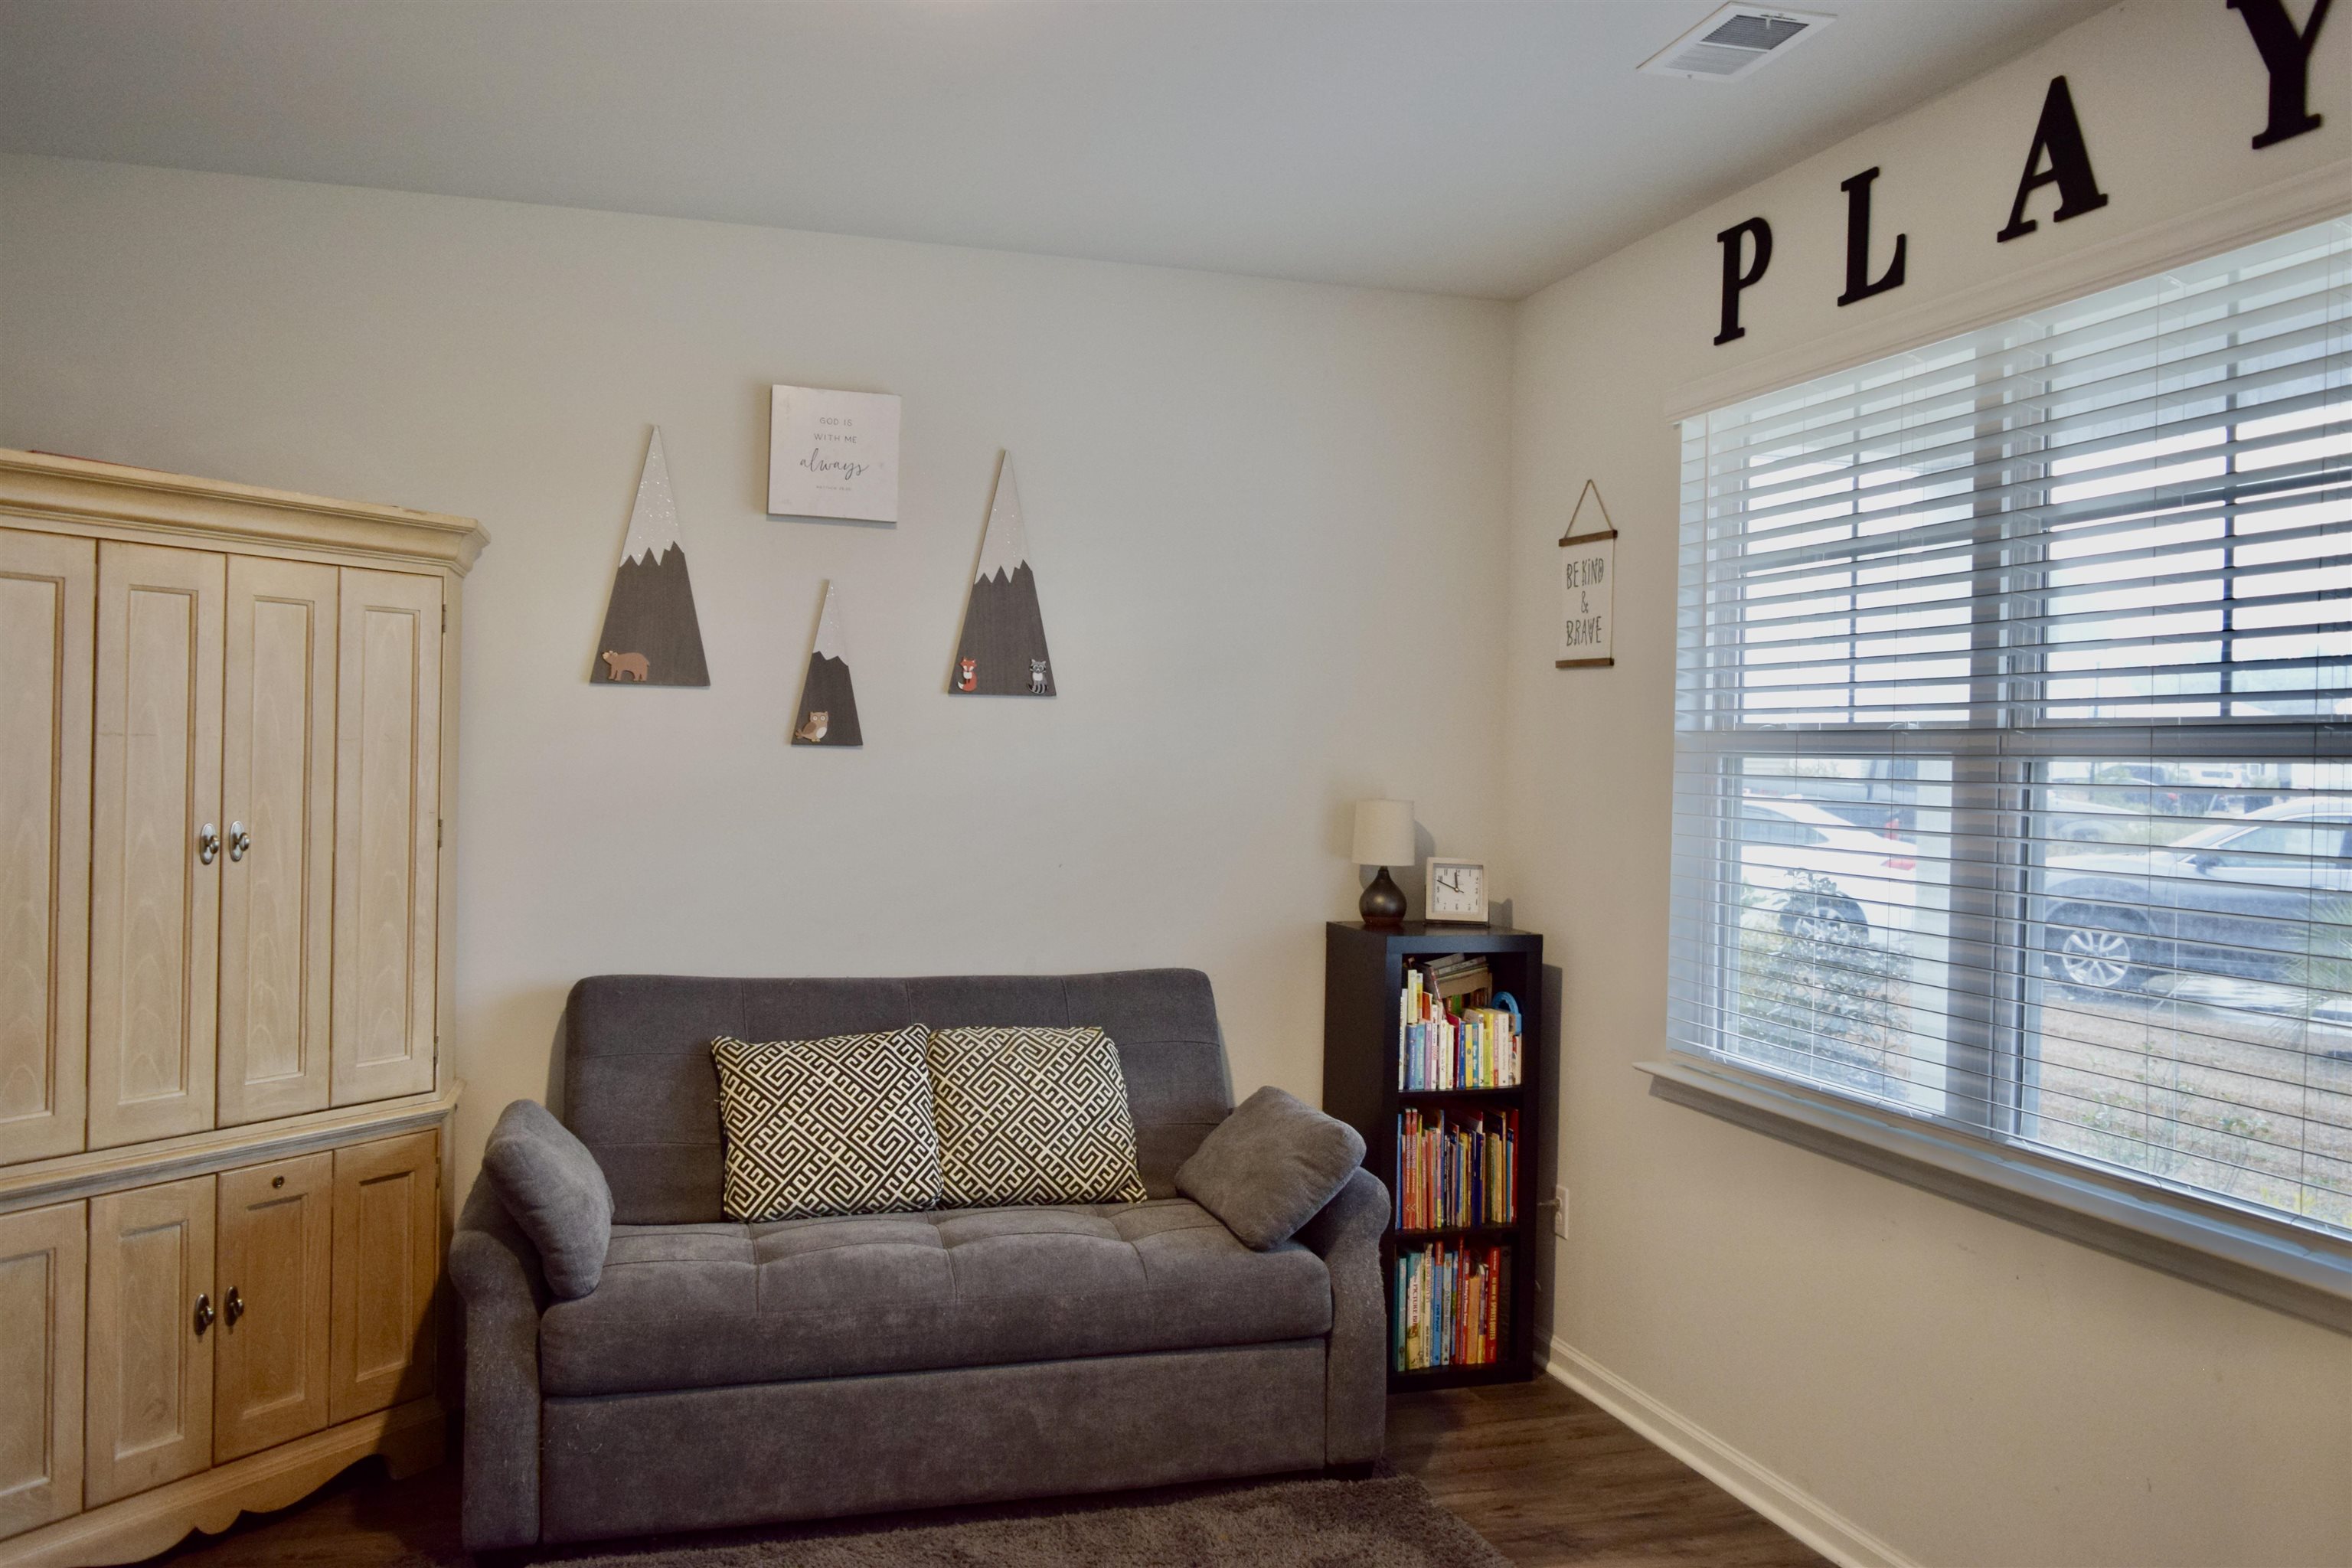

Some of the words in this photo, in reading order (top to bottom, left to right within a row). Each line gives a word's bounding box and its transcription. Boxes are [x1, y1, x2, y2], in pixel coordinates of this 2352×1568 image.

[1713, 0, 2333, 346] PLAY
[819, 417, 839, 426] GOD
[813, 433, 840, 442] WITH
[799, 448, 869, 480] always
[1566, 561, 1579, 590] BE
[1581, 590, 1589, 613] &
[1566, 616, 1602, 646] BRAVE
